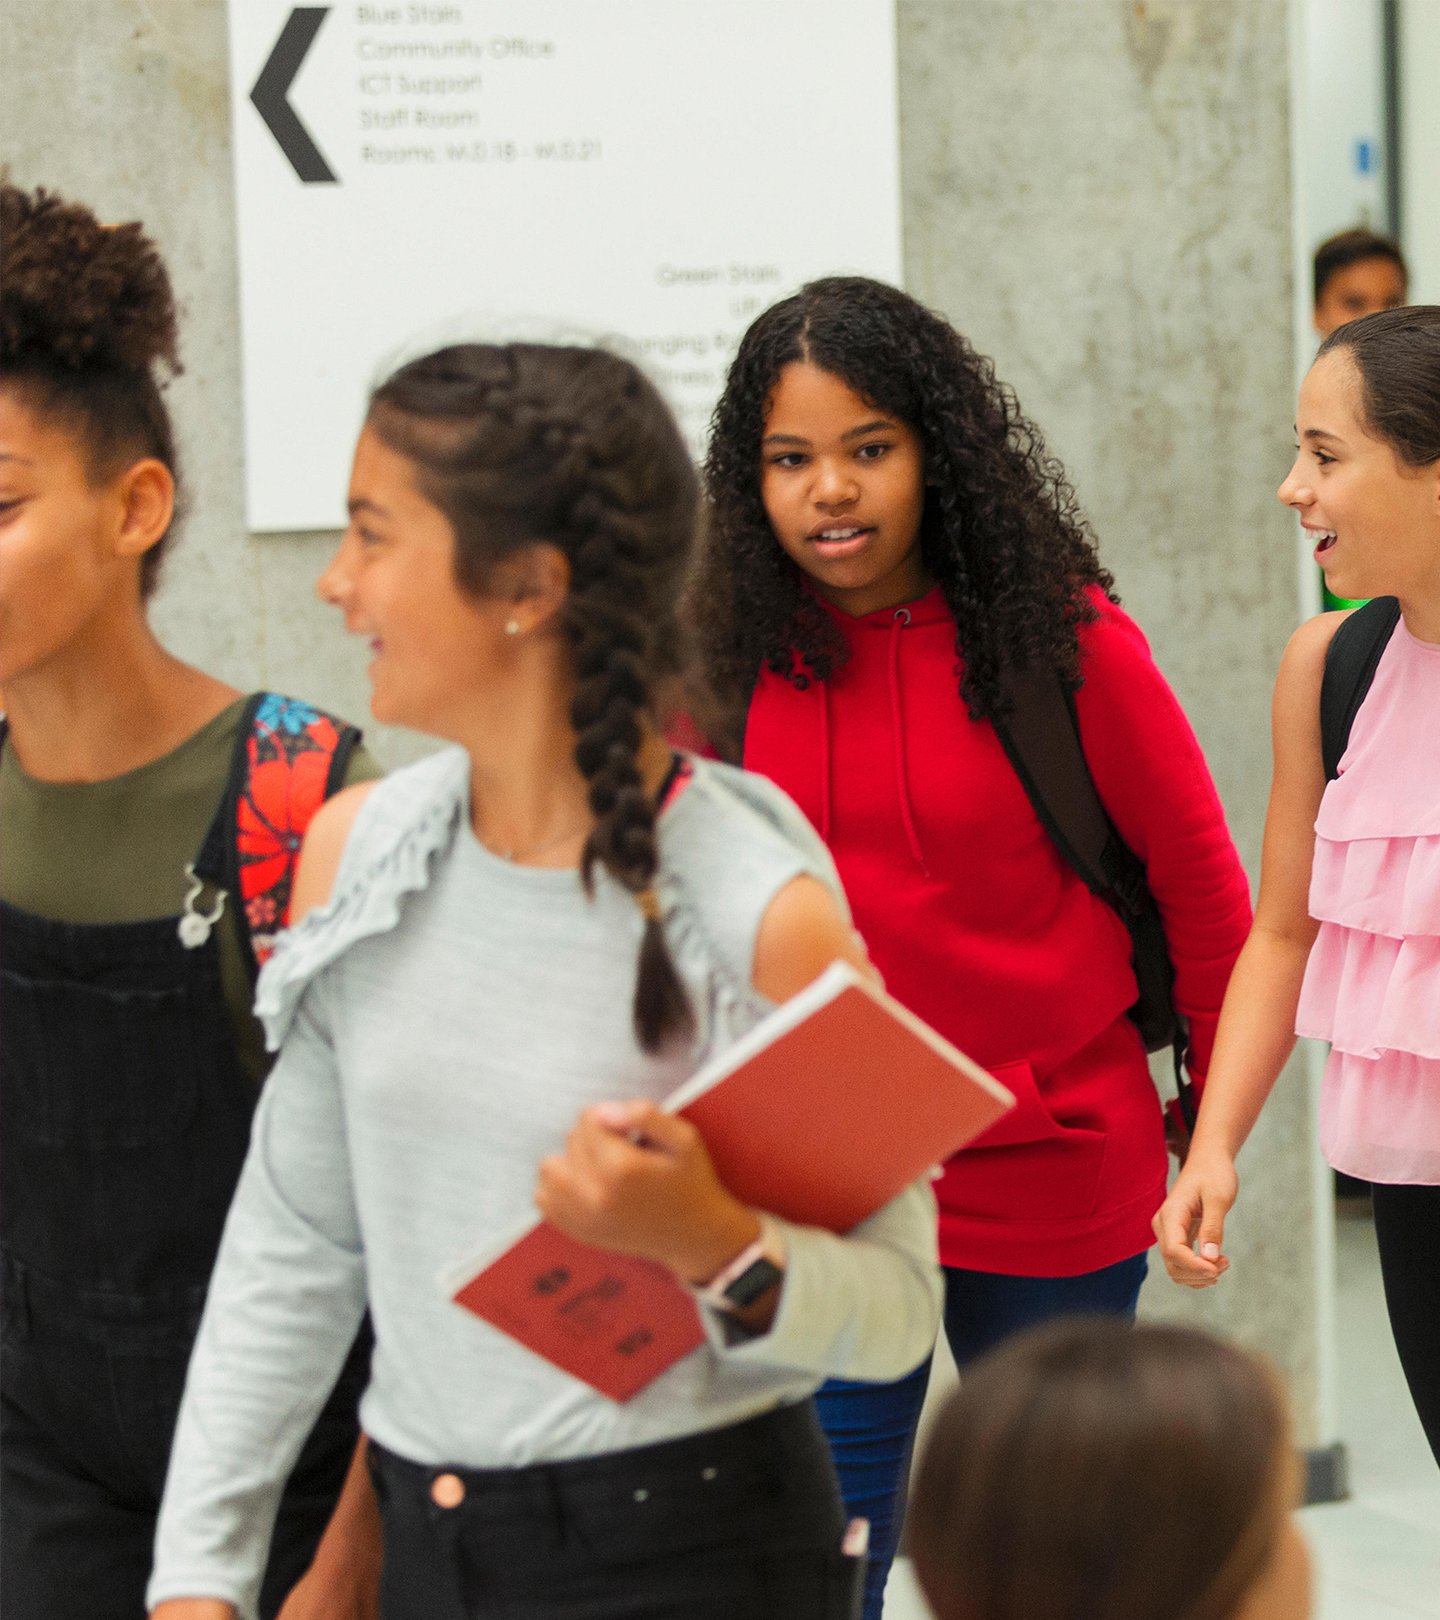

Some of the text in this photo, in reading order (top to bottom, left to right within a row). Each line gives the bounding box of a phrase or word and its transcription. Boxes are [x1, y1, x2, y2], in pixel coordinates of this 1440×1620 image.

[355, 3, 463, 25] Blue Stairs
[356, 35, 555, 61] Community Office
[357, 72, 483, 98] ICT Support
[358, 105, 480, 129] Staff Room
[655, 262, 781, 287] Green Stairs
